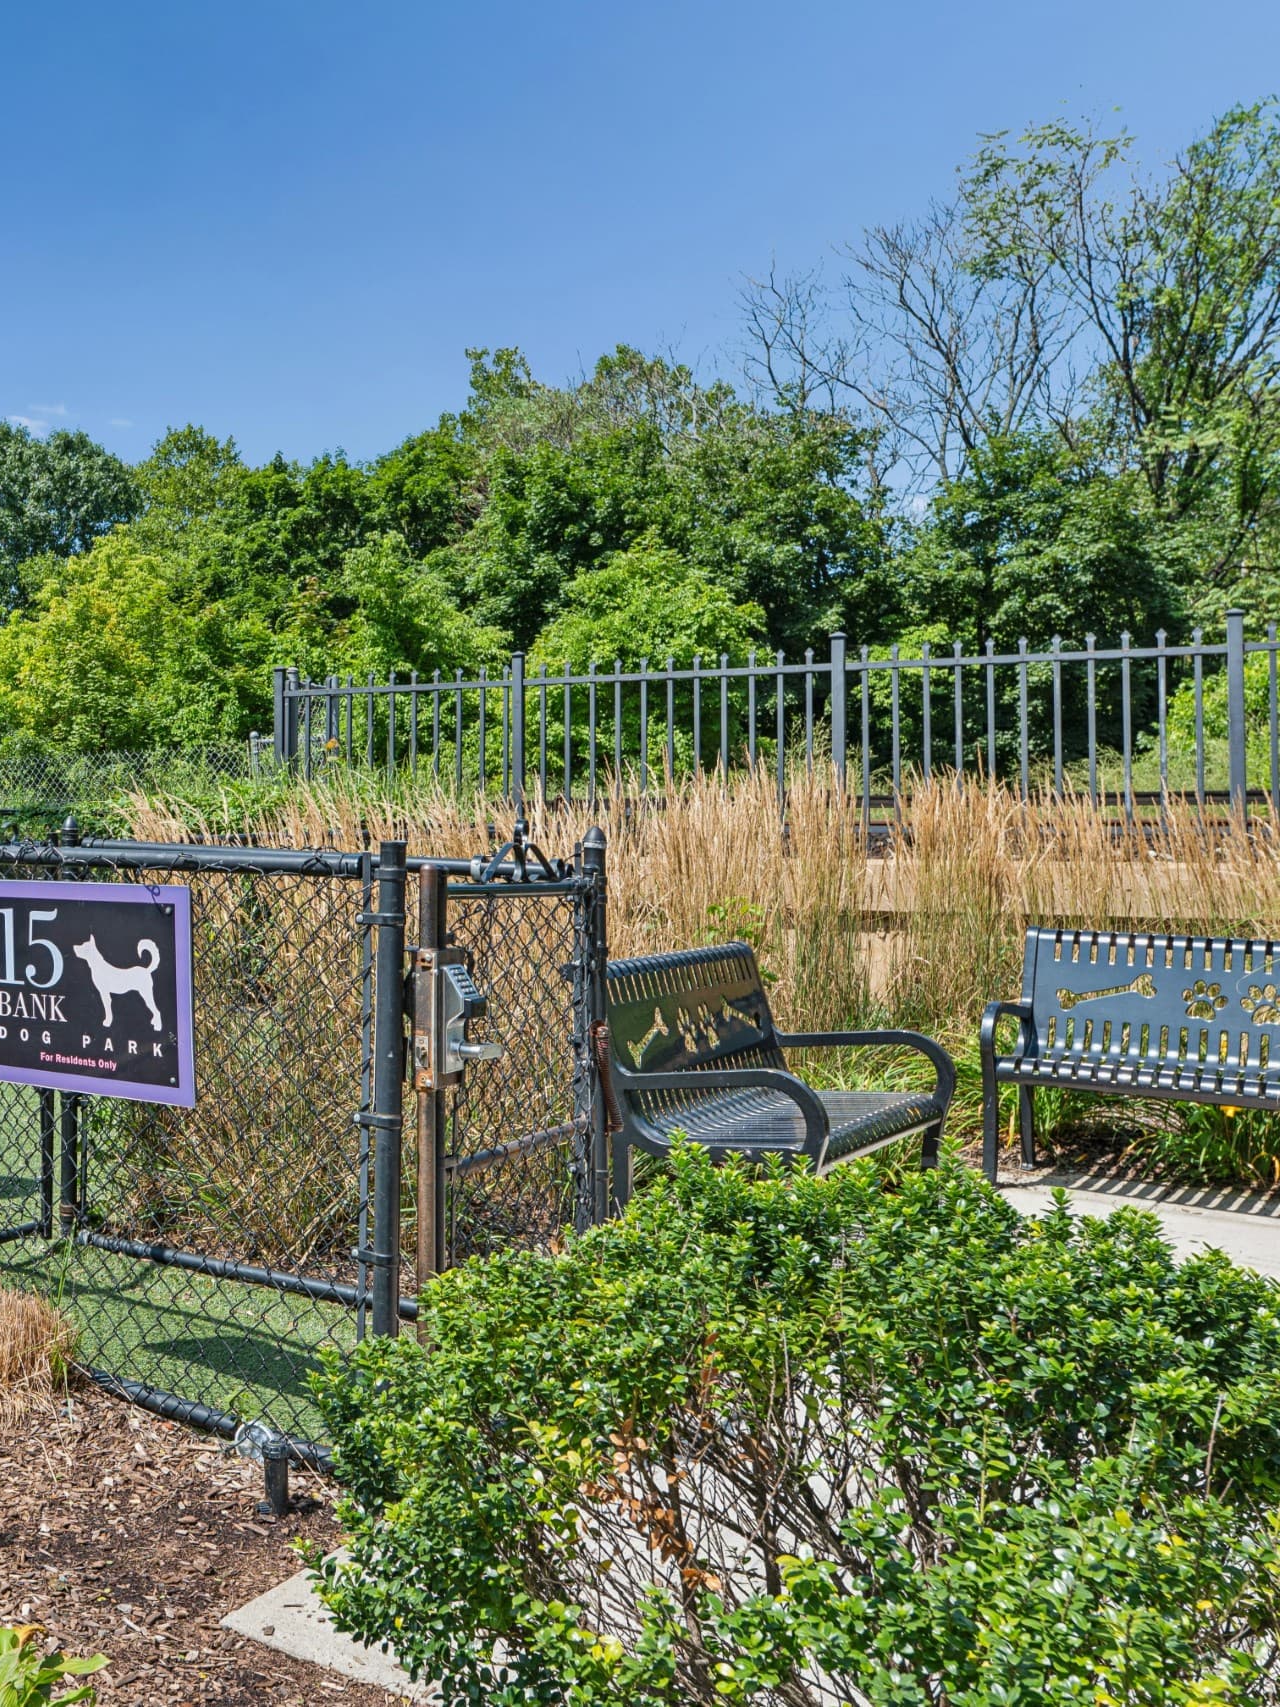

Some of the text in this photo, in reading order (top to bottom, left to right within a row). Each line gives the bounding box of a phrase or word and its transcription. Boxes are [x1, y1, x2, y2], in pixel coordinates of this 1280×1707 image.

[0, 1025, 163, 1058] DOG PARK
[40, 1051, 117, 1072] For Residents Only
